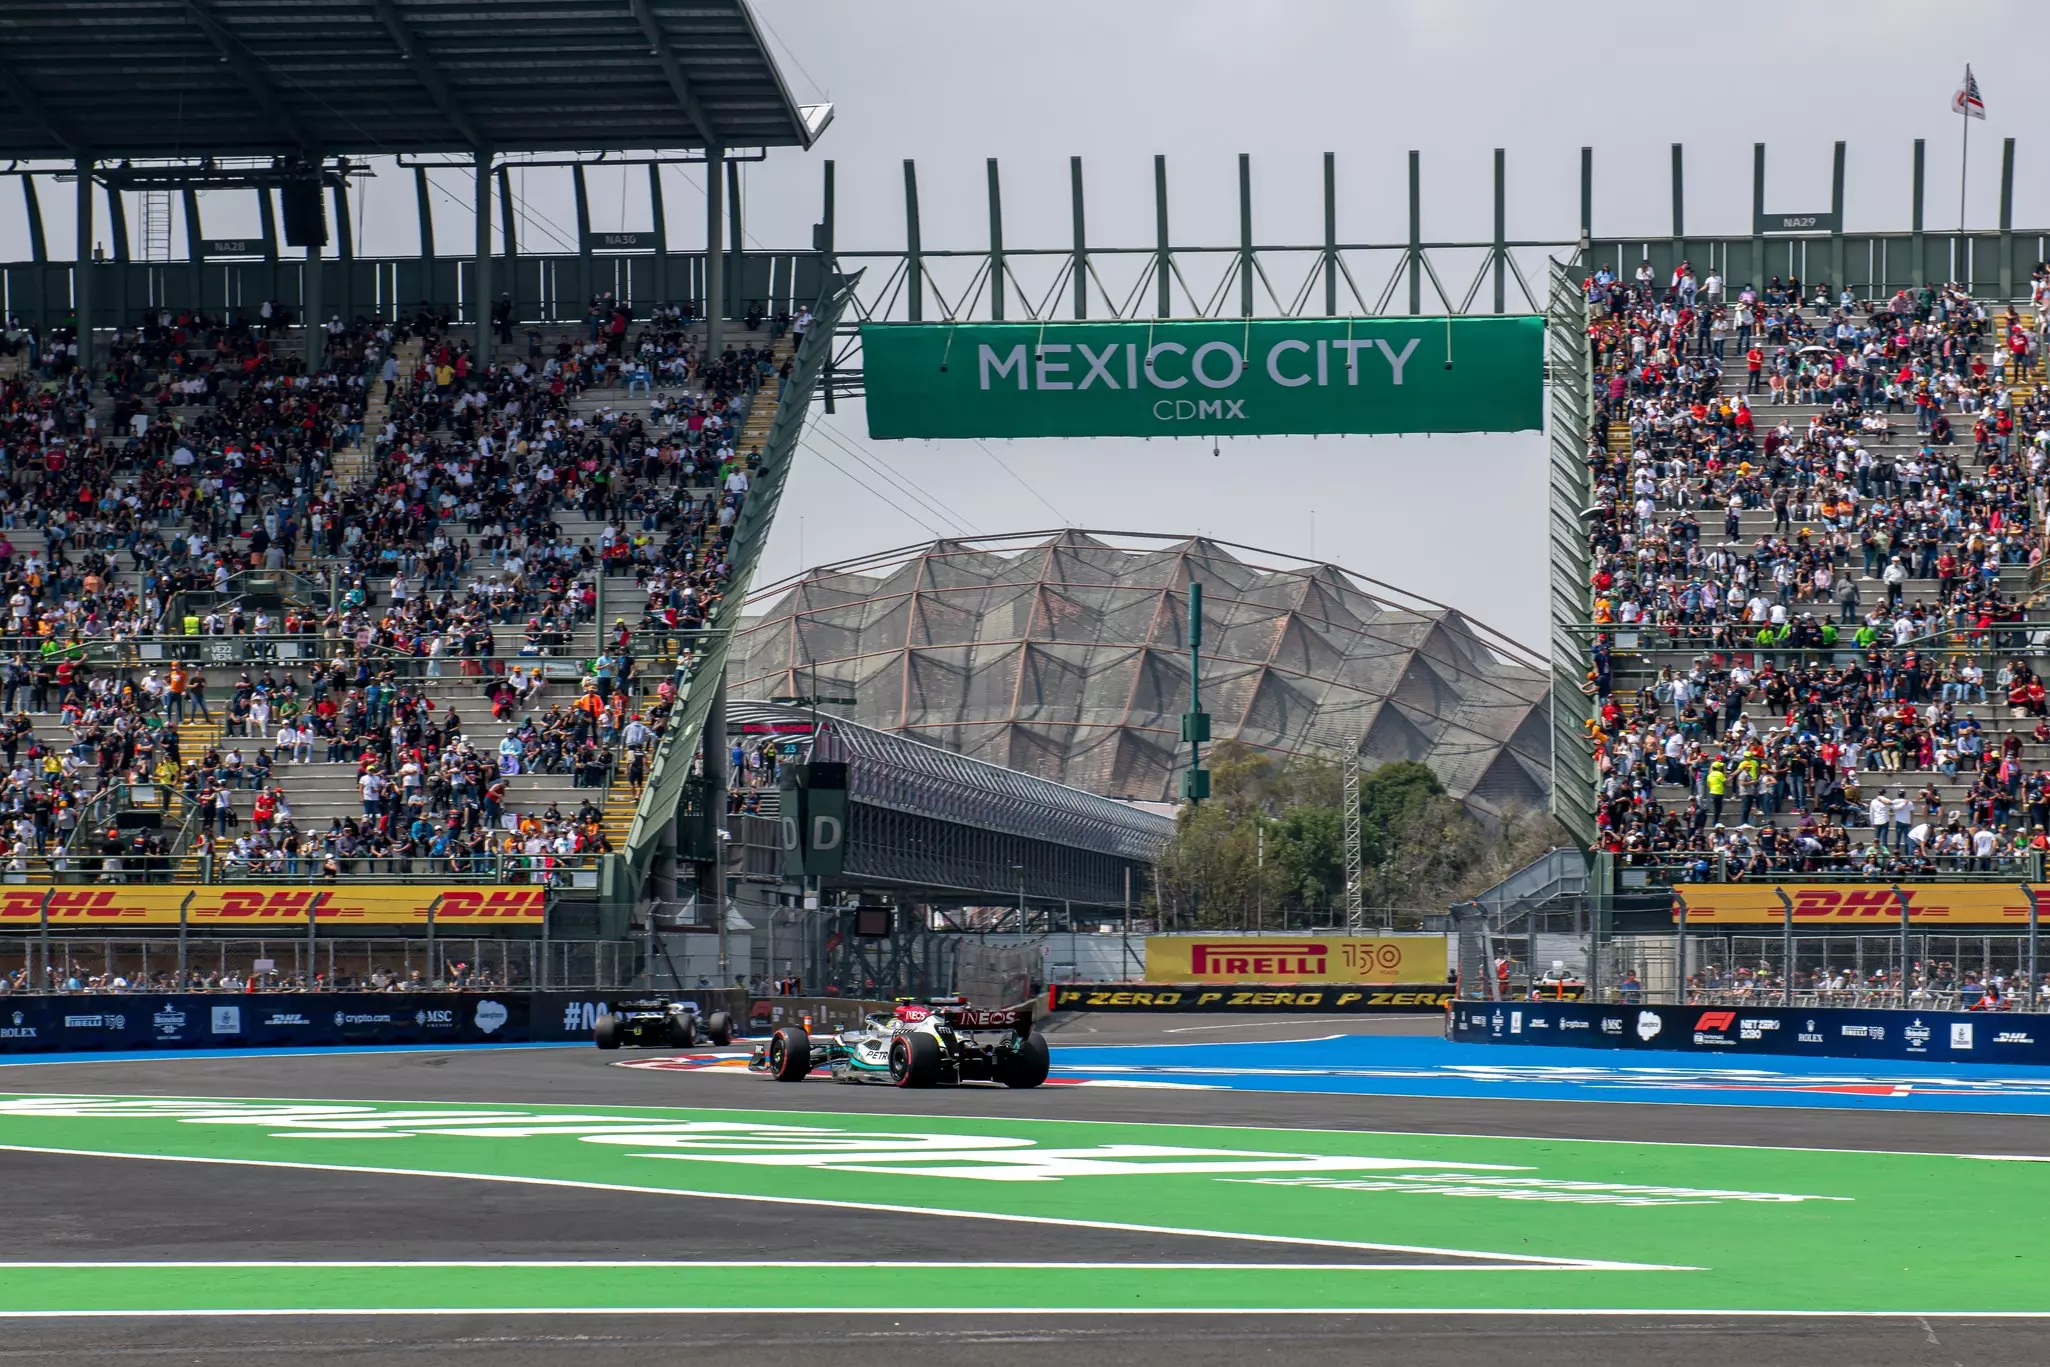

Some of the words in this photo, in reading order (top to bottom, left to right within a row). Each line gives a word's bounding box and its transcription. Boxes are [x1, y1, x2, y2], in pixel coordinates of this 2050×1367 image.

[1783, 217, 1816, 227] NA29
[978, 341, 1242, 391] MEXICO
[1266, 337, 1422, 387] CITY
[1153, 399, 1245, 420] CDMX
[784, 744, 796, 753] 23
[782, 816, 797, 850] D
[813, 815, 842, 850] D
[0, 891, 125, 917] DHL
[217, 891, 342, 917] DHL
[1794, 890, 1926, 916] DHL
[1192, 944, 1328, 975] PIRELLI
[1342, 944, 1402, 976] 150
[1058, 992, 1081, 1005] P
[1086, 992, 1182, 1005] ZERO
[1197, 993, 1223, 1006] P
[1227, 993, 1323, 1006] ZERO
[1336, 993, 1362, 1006] P
[65, 1015, 102, 1028] PIRELLI
[345, 1014, 391, 1024] crypto.com
[426, 1010, 453, 1022] MSC
[905, 1010, 926, 1020] INEOS
[961, 1011, 1017, 1025] INEOS
[1740, 1019, 1758, 1029] NET
[0, 1027, 37, 1038] ROLEX
[1798, 1033, 1824, 1043] ROLEX
[2000, 1033, 2028, 1043] DHL
